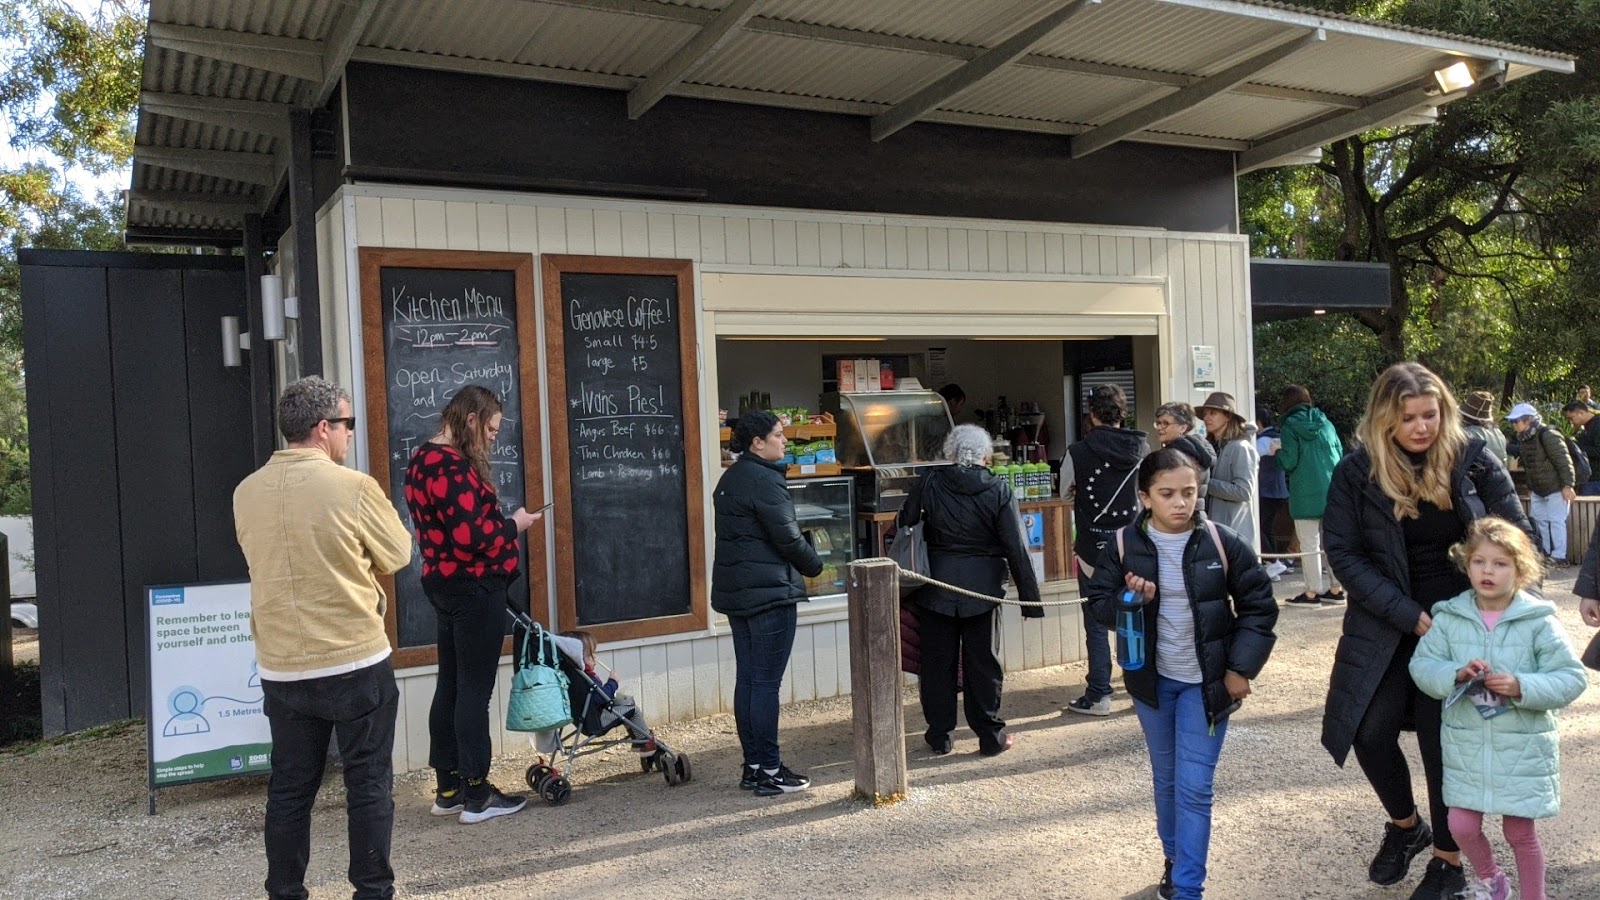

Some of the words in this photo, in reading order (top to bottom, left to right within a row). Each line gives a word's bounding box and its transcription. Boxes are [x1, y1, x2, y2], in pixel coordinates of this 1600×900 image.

[392, 285, 462, 323] Kitchen
[464, 287, 504, 320] Menu
[570, 299, 624, 331] Genovese
[627, 296, 671, 330] Coffee!
[416, 328, 445, 347] 12pm
[459, 328, 488, 346] 2pm
[587, 353, 616, 376] large
[631, 355, 648, 372] $5
[396, 368, 442, 398] Open
[451, 361, 513, 394] Saturday
[413, 389, 436, 408] and
[626, 384, 663, 415] Pies!
[610, 420, 636, 439] Beef
[577, 445, 600, 460] Thai
[603, 444, 645, 460] Chicken
[499, 471, 513, 486] $8
[156, 613, 217, 626] Remember
[220, 612, 231, 621] to
[234, 610, 251, 620] lea
[156, 627, 190, 639] space
[193, 623, 240, 635] between
[156, 637, 204, 651] yourself
[206, 634, 227, 646] and
[230, 633, 254, 643] othe
[218, 709, 230, 718] 1.5
[232, 706, 262, 717] Metres
